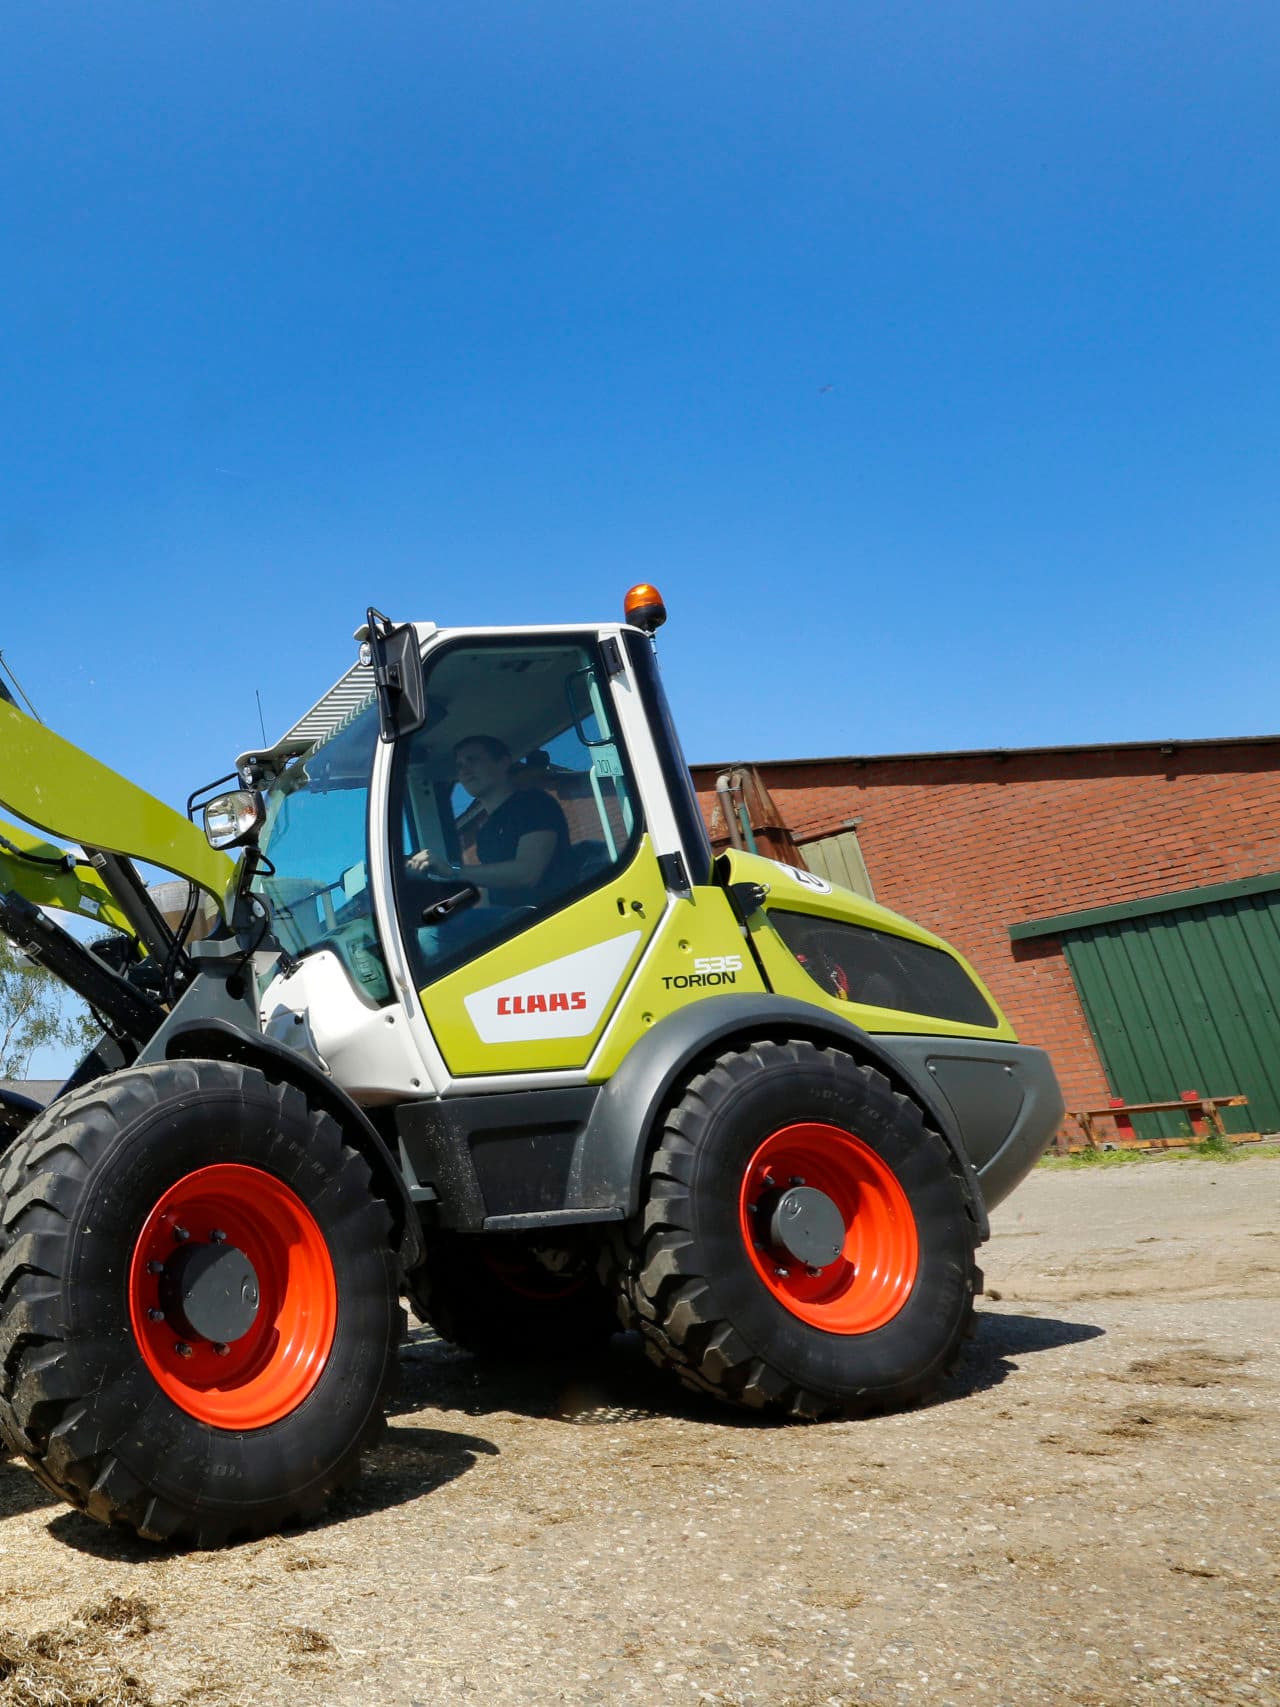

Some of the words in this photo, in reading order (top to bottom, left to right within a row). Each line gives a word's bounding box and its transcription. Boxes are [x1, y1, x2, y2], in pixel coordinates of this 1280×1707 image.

[693, 955, 743, 975] 535
[661, 971, 736, 990] TORION
[497, 991, 587, 1016] CLAAS
